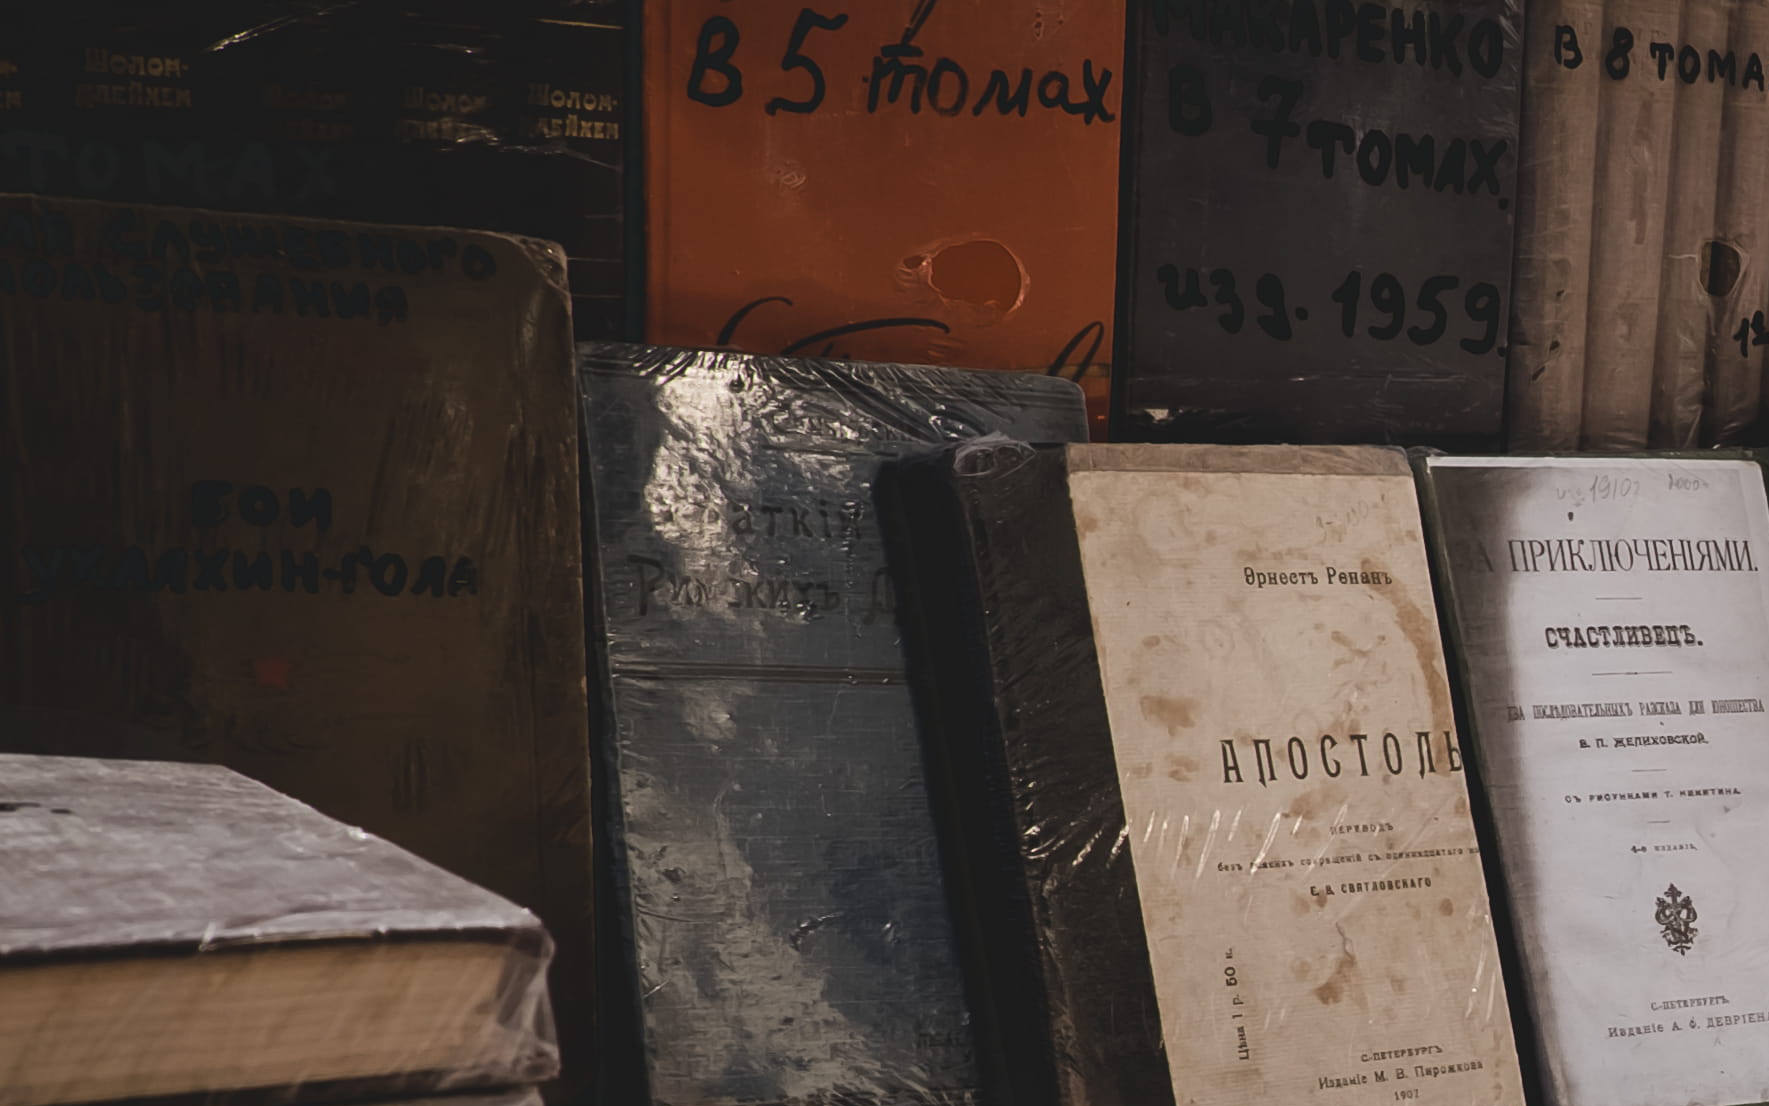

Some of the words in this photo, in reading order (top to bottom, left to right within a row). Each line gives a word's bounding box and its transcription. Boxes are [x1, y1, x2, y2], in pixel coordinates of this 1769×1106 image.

[687, 14, 743, 108] В
[766, 8, 850, 117] 5
[1555, 26, 1582, 68] В
[1606, 27, 1634, 80] 8
[1168, 64, 1212, 136] В
[1251, 75, 1303, 168] 7
[1157, 263, 1308, 340] изд.
[190, 479, 334, 532] БОИ
[1244, 567, 1319, 588] Эрнестъ
[1327, 567, 1393, 586] Ренанъ
[1507, 538, 1760, 573] ПРИКЛЮЧЕНІЯМИ.
[1545, 624, 1705, 650] СЧАСТЛИВЕЦЪ.
